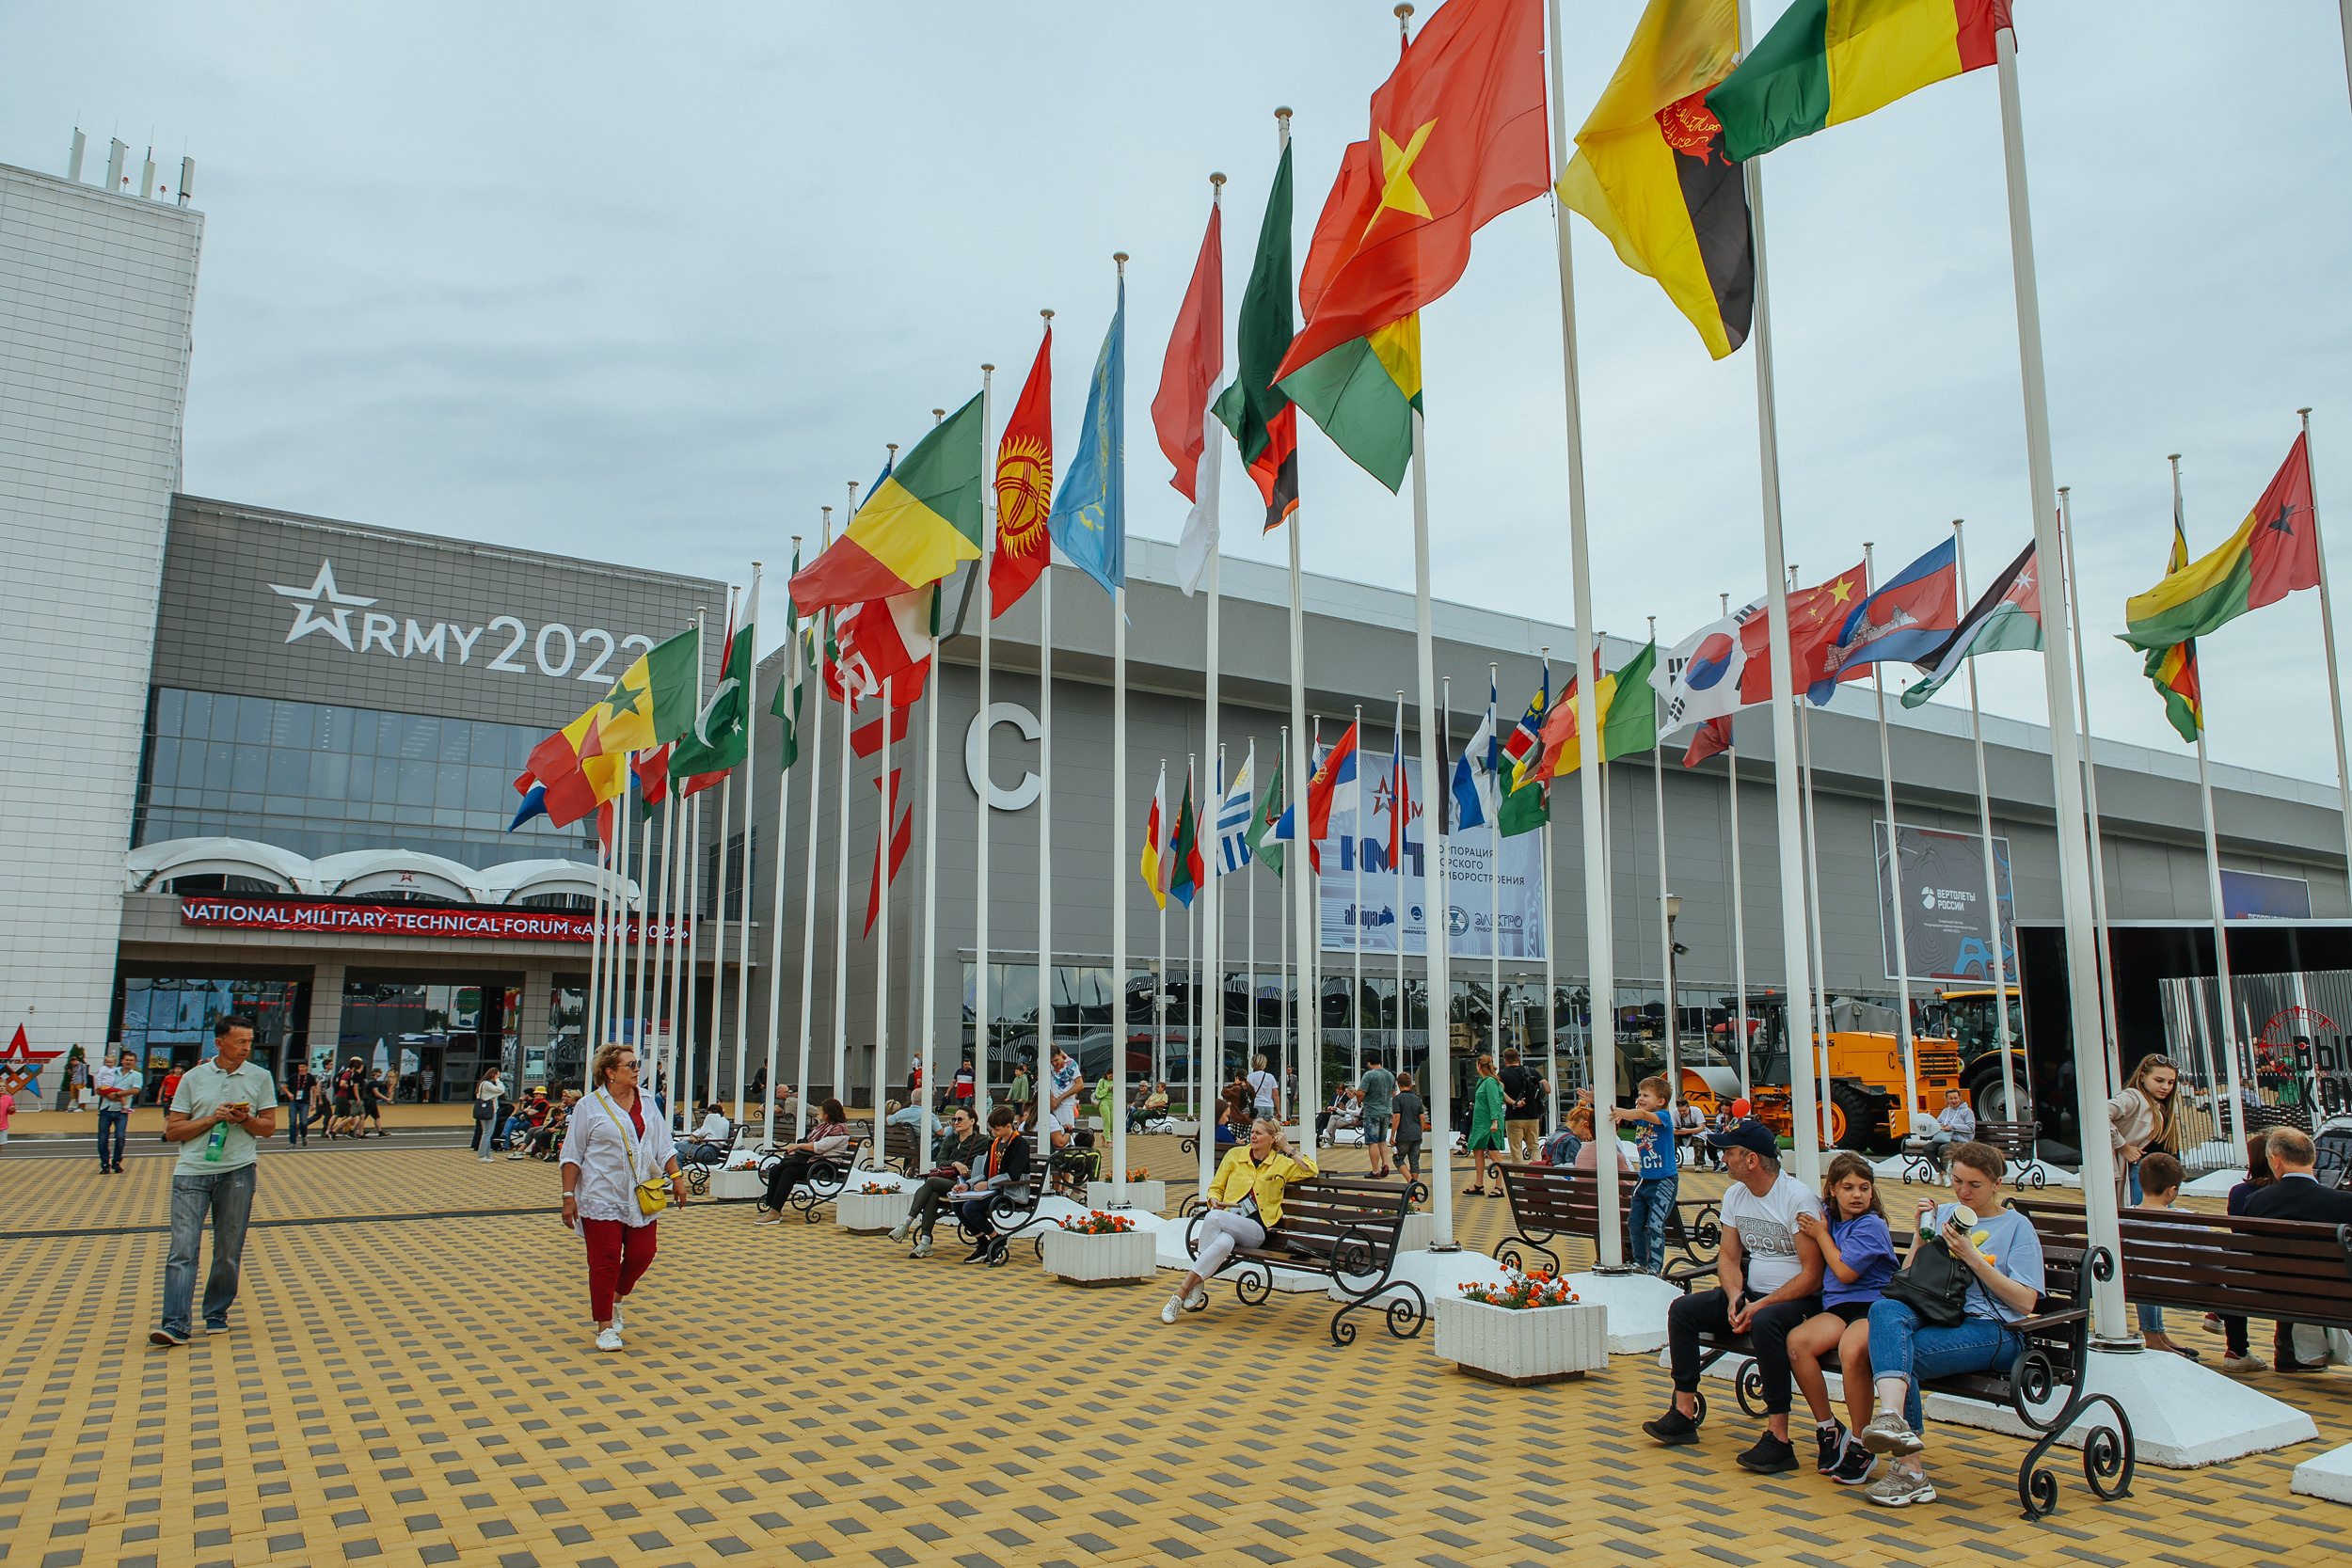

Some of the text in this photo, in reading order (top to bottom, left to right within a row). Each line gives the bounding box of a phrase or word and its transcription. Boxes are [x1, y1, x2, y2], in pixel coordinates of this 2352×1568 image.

[1438, 845, 1493, 859] ОПОРАЦИЯ
[1439, 858, 1484, 870] ОРСКОГО
[1440, 871, 1525, 886] РИБОРОСТРОЕНИЯ
[1936, 889, 1977, 901] ВЕРТОЛЕТЫ
[1937, 900, 1964, 911] РОССИИ
[182, 904, 291, 924] NATIONAL
[294, 910, 501, 932] MILITARY-TECHNICAL
[503, 918, 569, 936] FORUM
[1344, 903, 1378, 930] авора
[1738, 1217, 1785, 1237] CERRUTI
